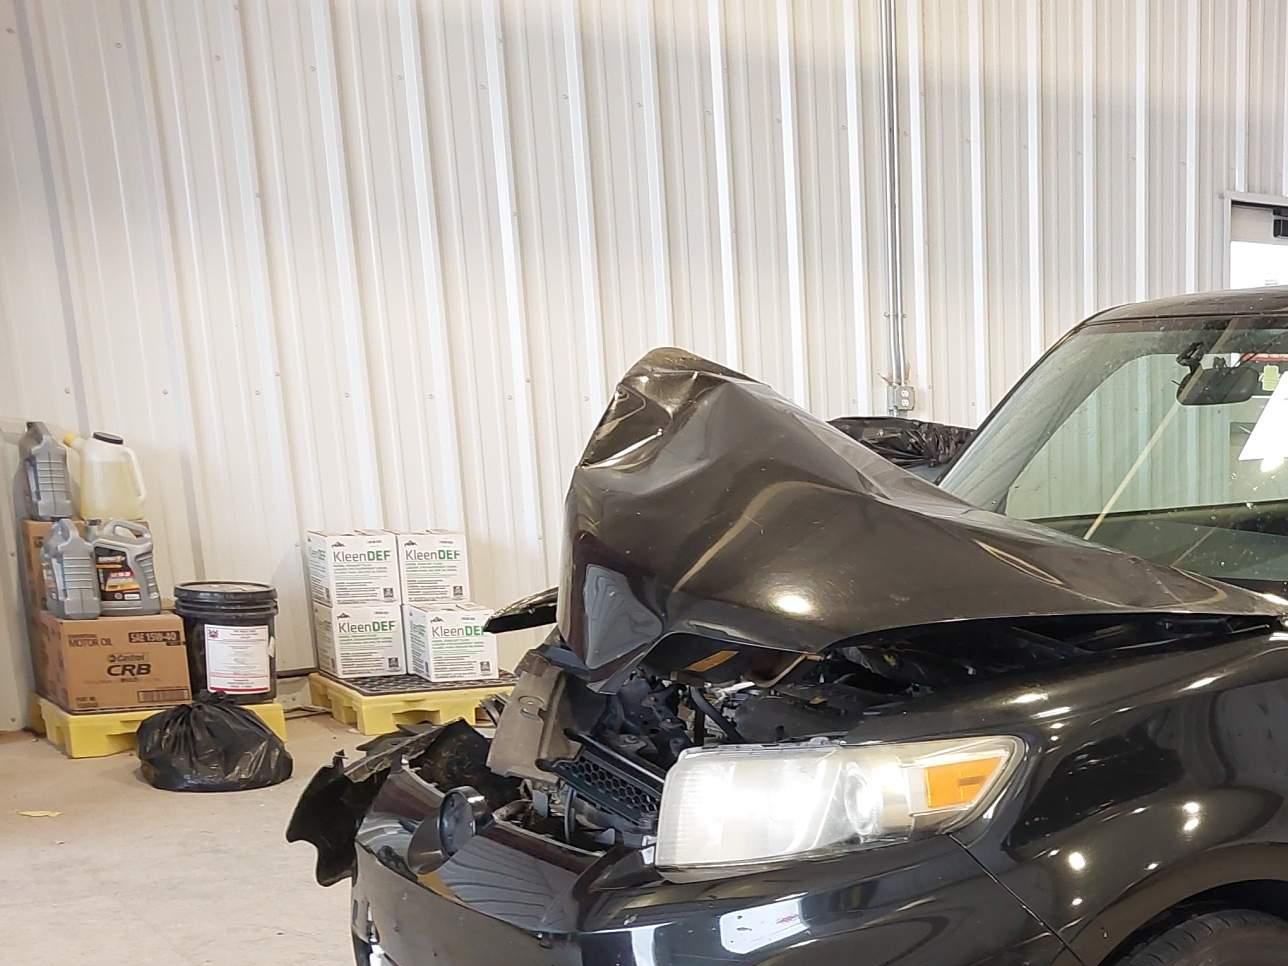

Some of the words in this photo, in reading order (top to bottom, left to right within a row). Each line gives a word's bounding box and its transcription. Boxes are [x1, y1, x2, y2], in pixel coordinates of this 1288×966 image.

[333, 550, 391, 562] KleenDEF
[405, 549, 461, 561] KleenDEF
[339, 621, 396, 633] KleenDEF
[68, 638, 99, 648] MOTOR
[130, 632, 145, 643] SAE
[107, 663, 151, 676] CRB
